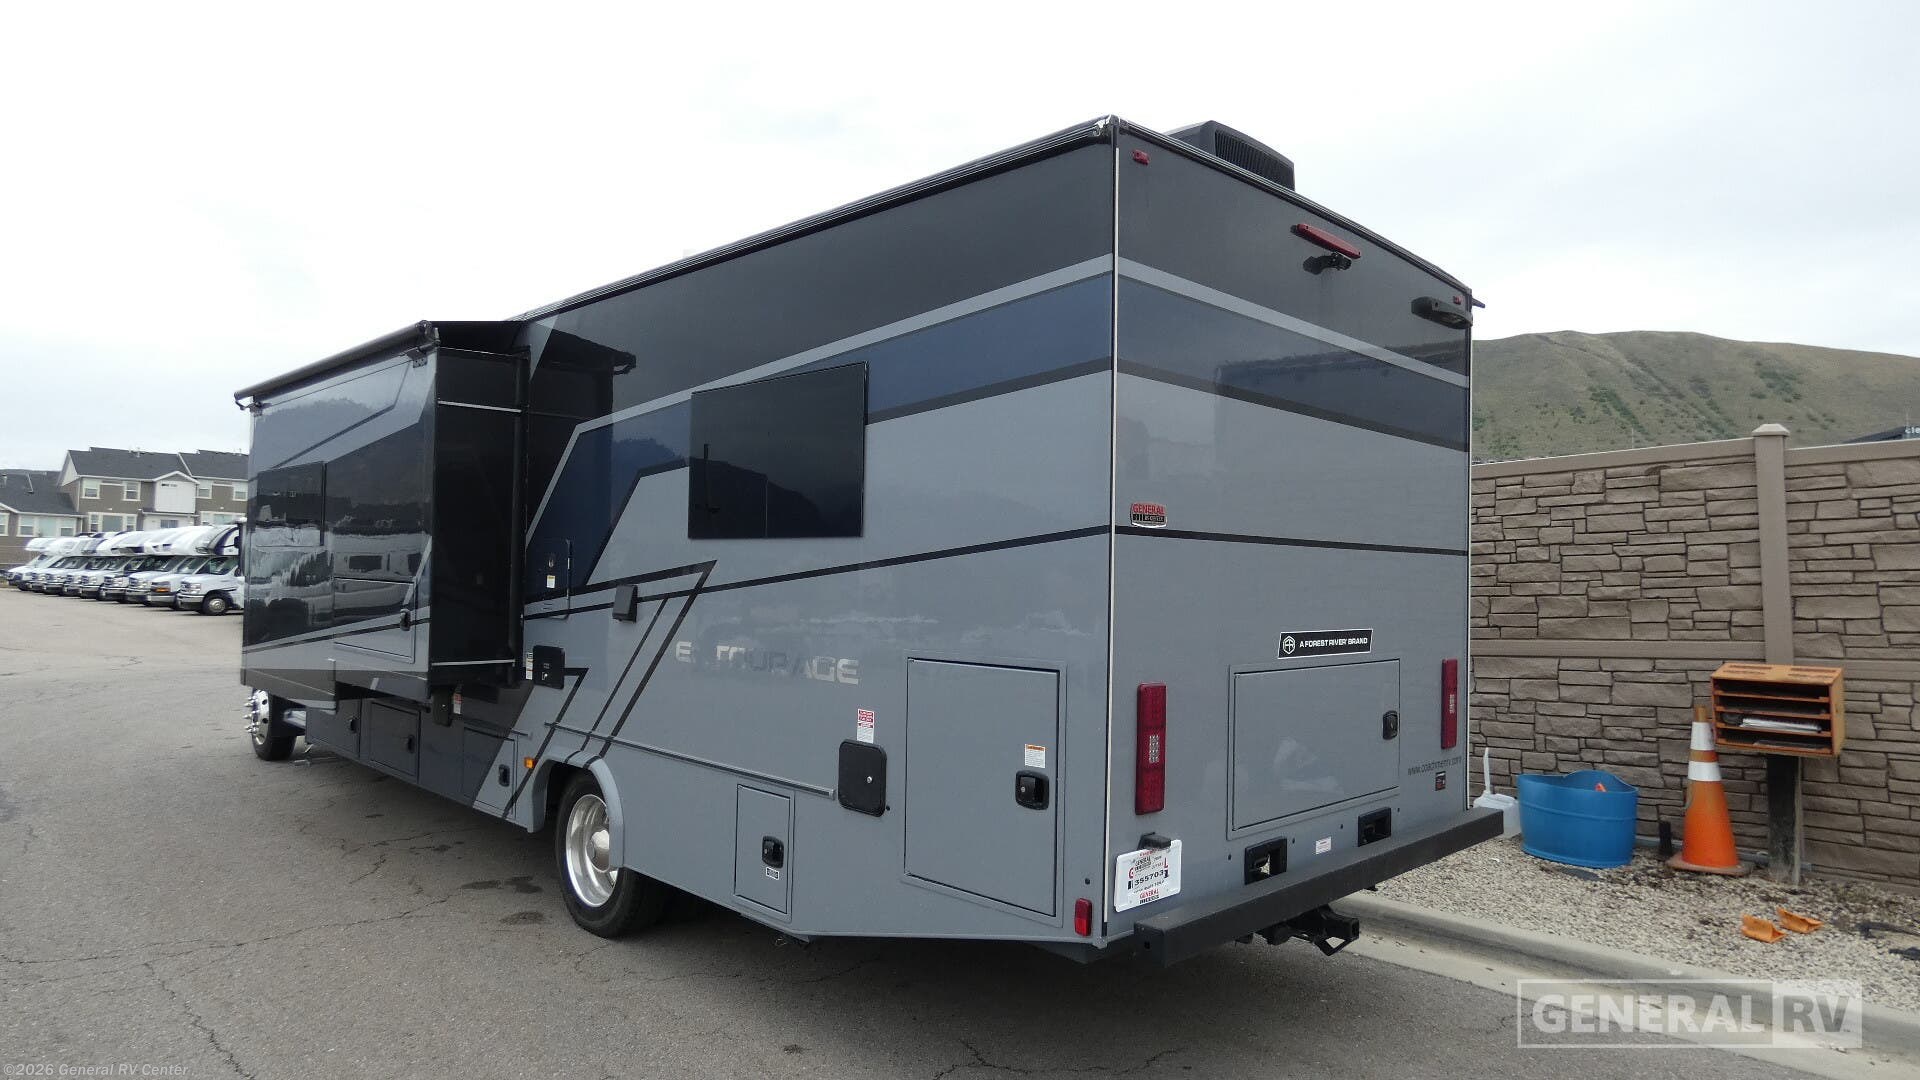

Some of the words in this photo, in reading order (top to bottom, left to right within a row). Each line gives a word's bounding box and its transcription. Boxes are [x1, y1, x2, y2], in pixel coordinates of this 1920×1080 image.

[1132, 503, 1165, 515] GENERAL
[1305, 639, 1328, 648] FOREST
[1348, 637, 1368, 645] BRAND
